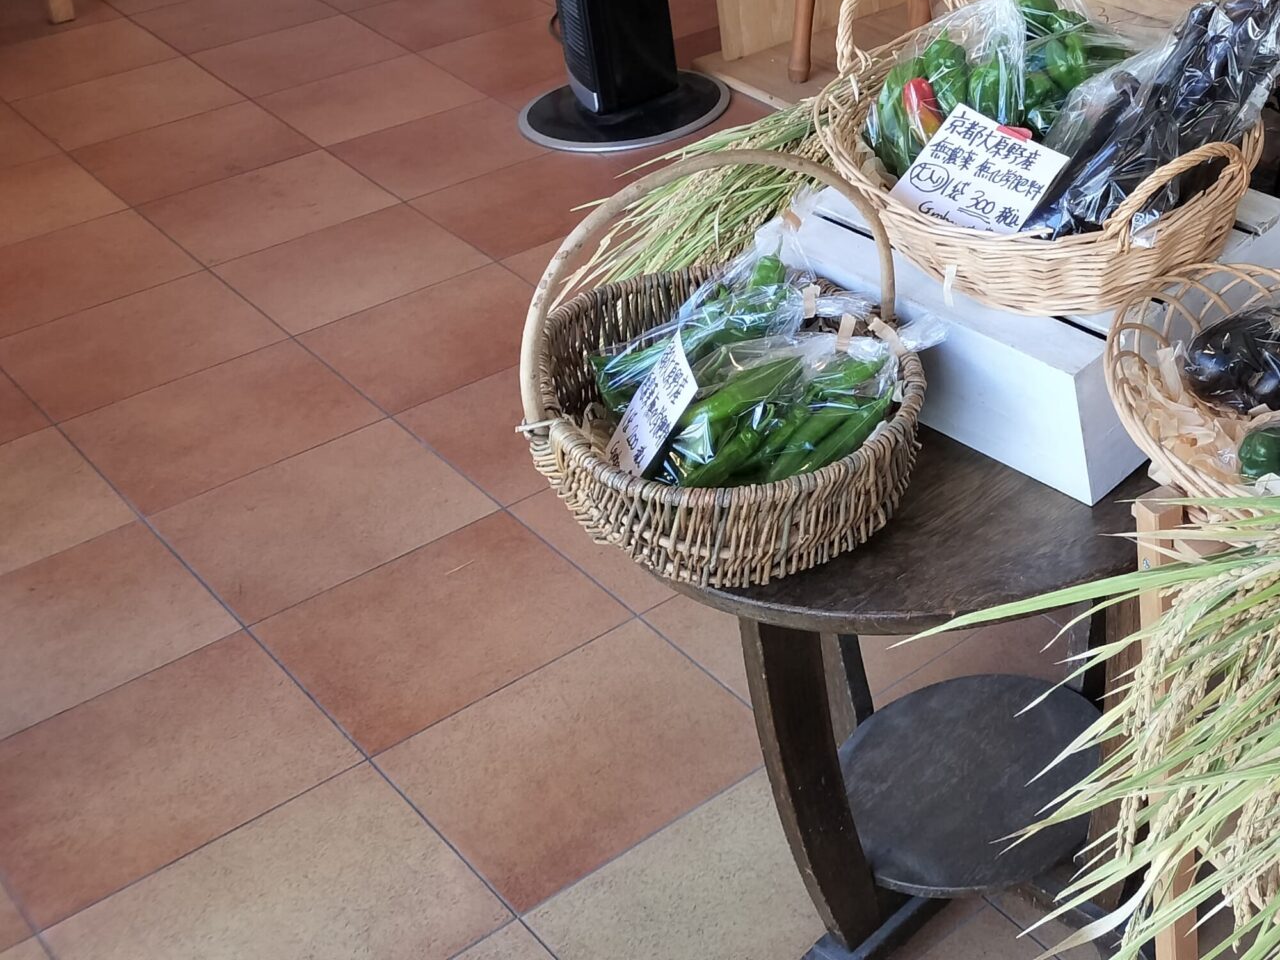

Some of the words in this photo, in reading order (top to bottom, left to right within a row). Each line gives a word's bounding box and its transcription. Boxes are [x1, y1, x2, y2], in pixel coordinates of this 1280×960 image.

[945, 110, 1042, 172] 京都大原野産
[965, 190, 996, 216] 300
